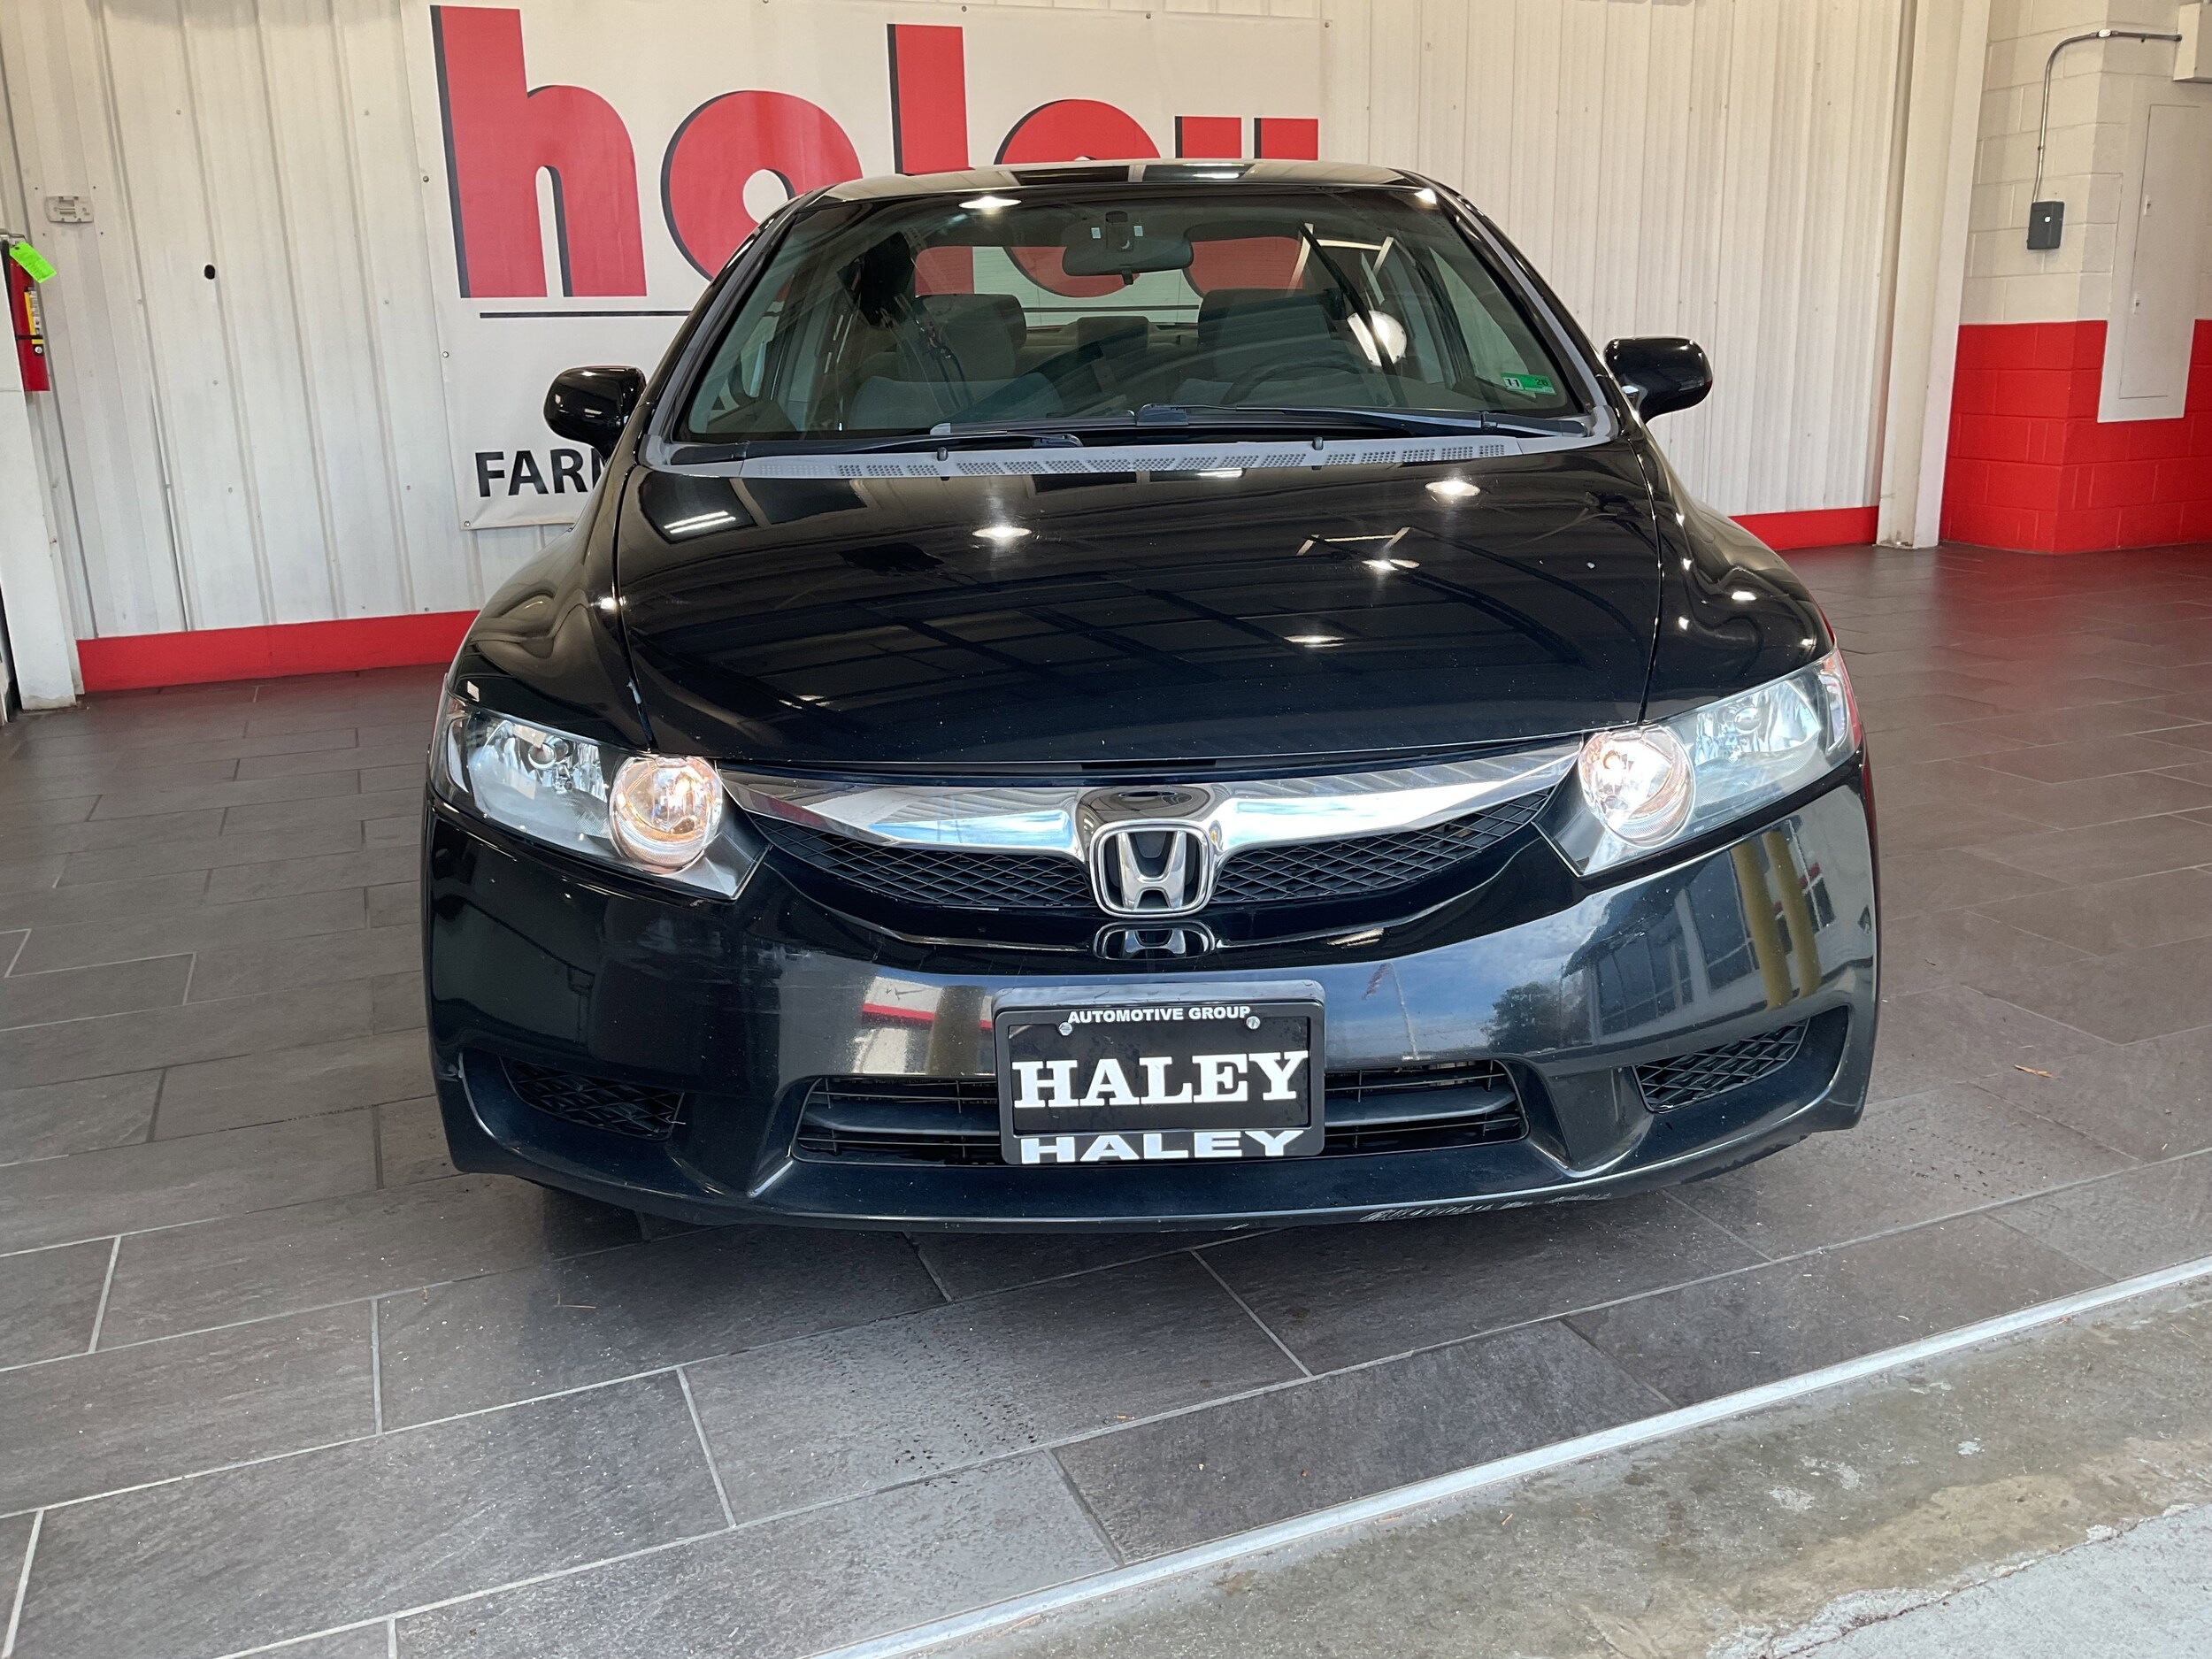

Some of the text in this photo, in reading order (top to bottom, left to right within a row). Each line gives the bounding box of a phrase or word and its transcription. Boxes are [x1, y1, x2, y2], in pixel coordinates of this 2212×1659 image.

[1068, 1006, 1251, 1024] AUTOMOTIVE GROUP
[1012, 1050, 1309, 1109] HALEY
[1021, 1131, 1305, 1164] HALEY
